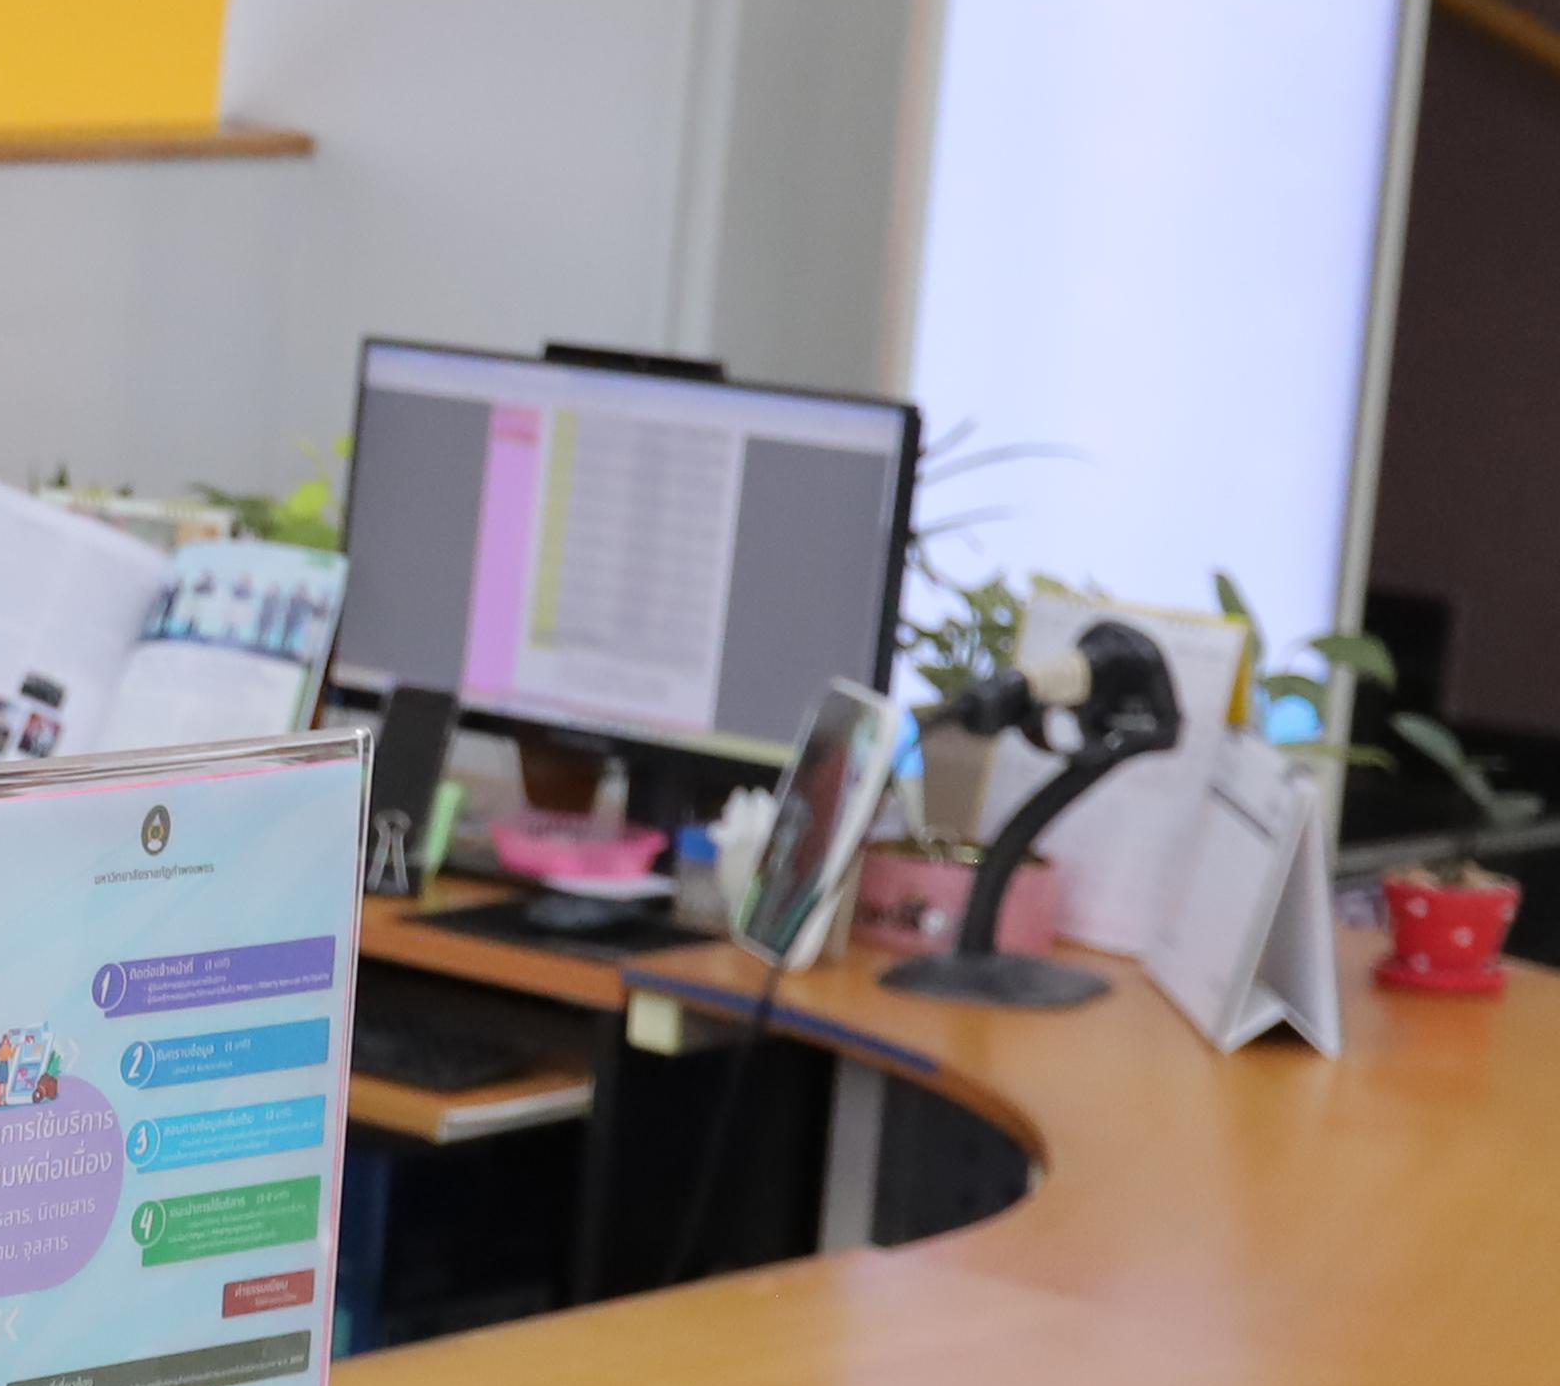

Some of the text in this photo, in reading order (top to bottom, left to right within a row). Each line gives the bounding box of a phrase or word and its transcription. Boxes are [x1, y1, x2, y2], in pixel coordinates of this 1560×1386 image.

[128, 1045, 142, 1079] 2
[134, 1125, 146, 1155] 3
[38, 1196, 95, 1222] นิตยสาร
[139, 1207, 153, 1240] 4
